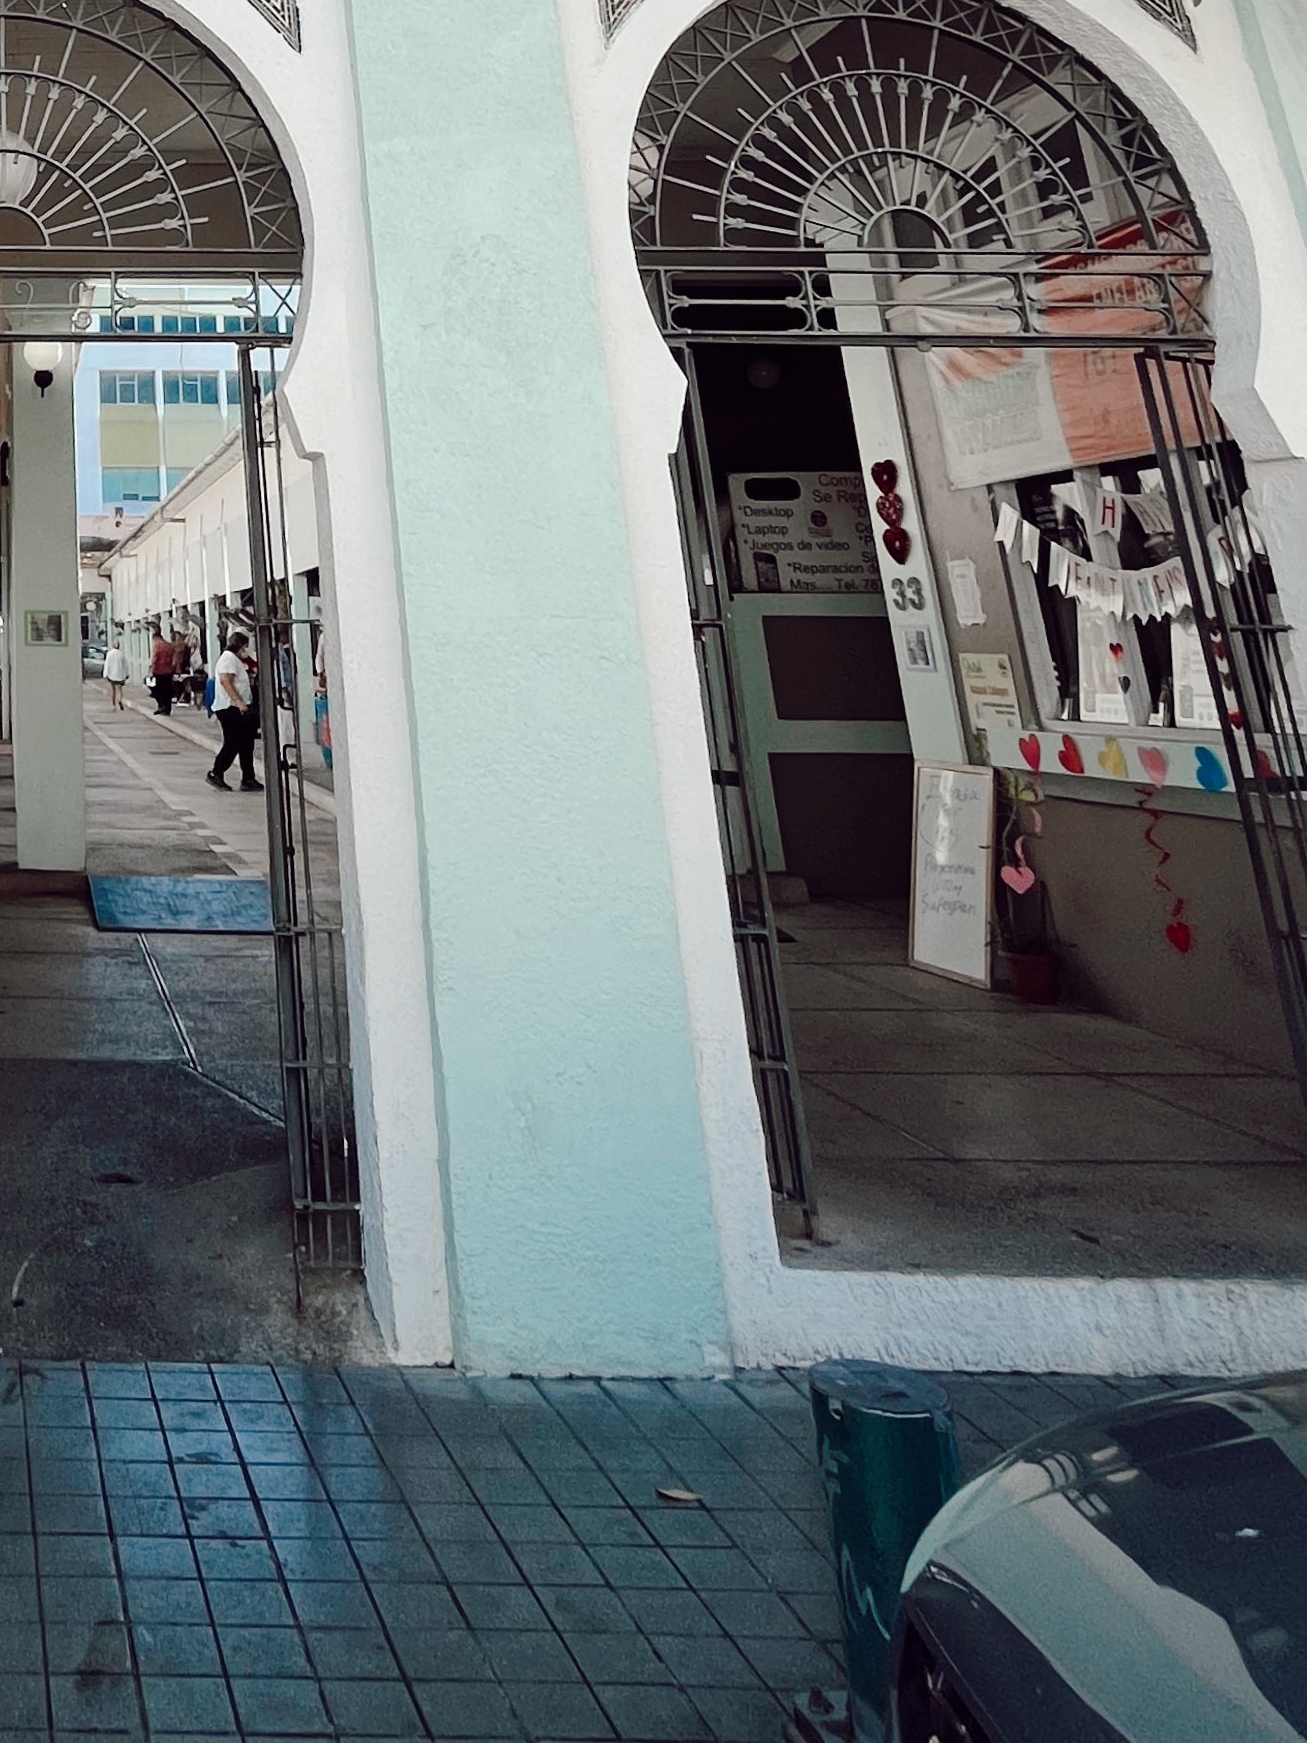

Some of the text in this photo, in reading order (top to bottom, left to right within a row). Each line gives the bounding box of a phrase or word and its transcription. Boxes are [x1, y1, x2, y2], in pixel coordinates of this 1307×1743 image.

[812, 489, 833, 504] Se
[742, 506, 794, 521] Desktop
[745, 523, 789, 537] Laptop
[748, 539, 851, 554] Juegos de video
[891, 575, 926, 611] 33
